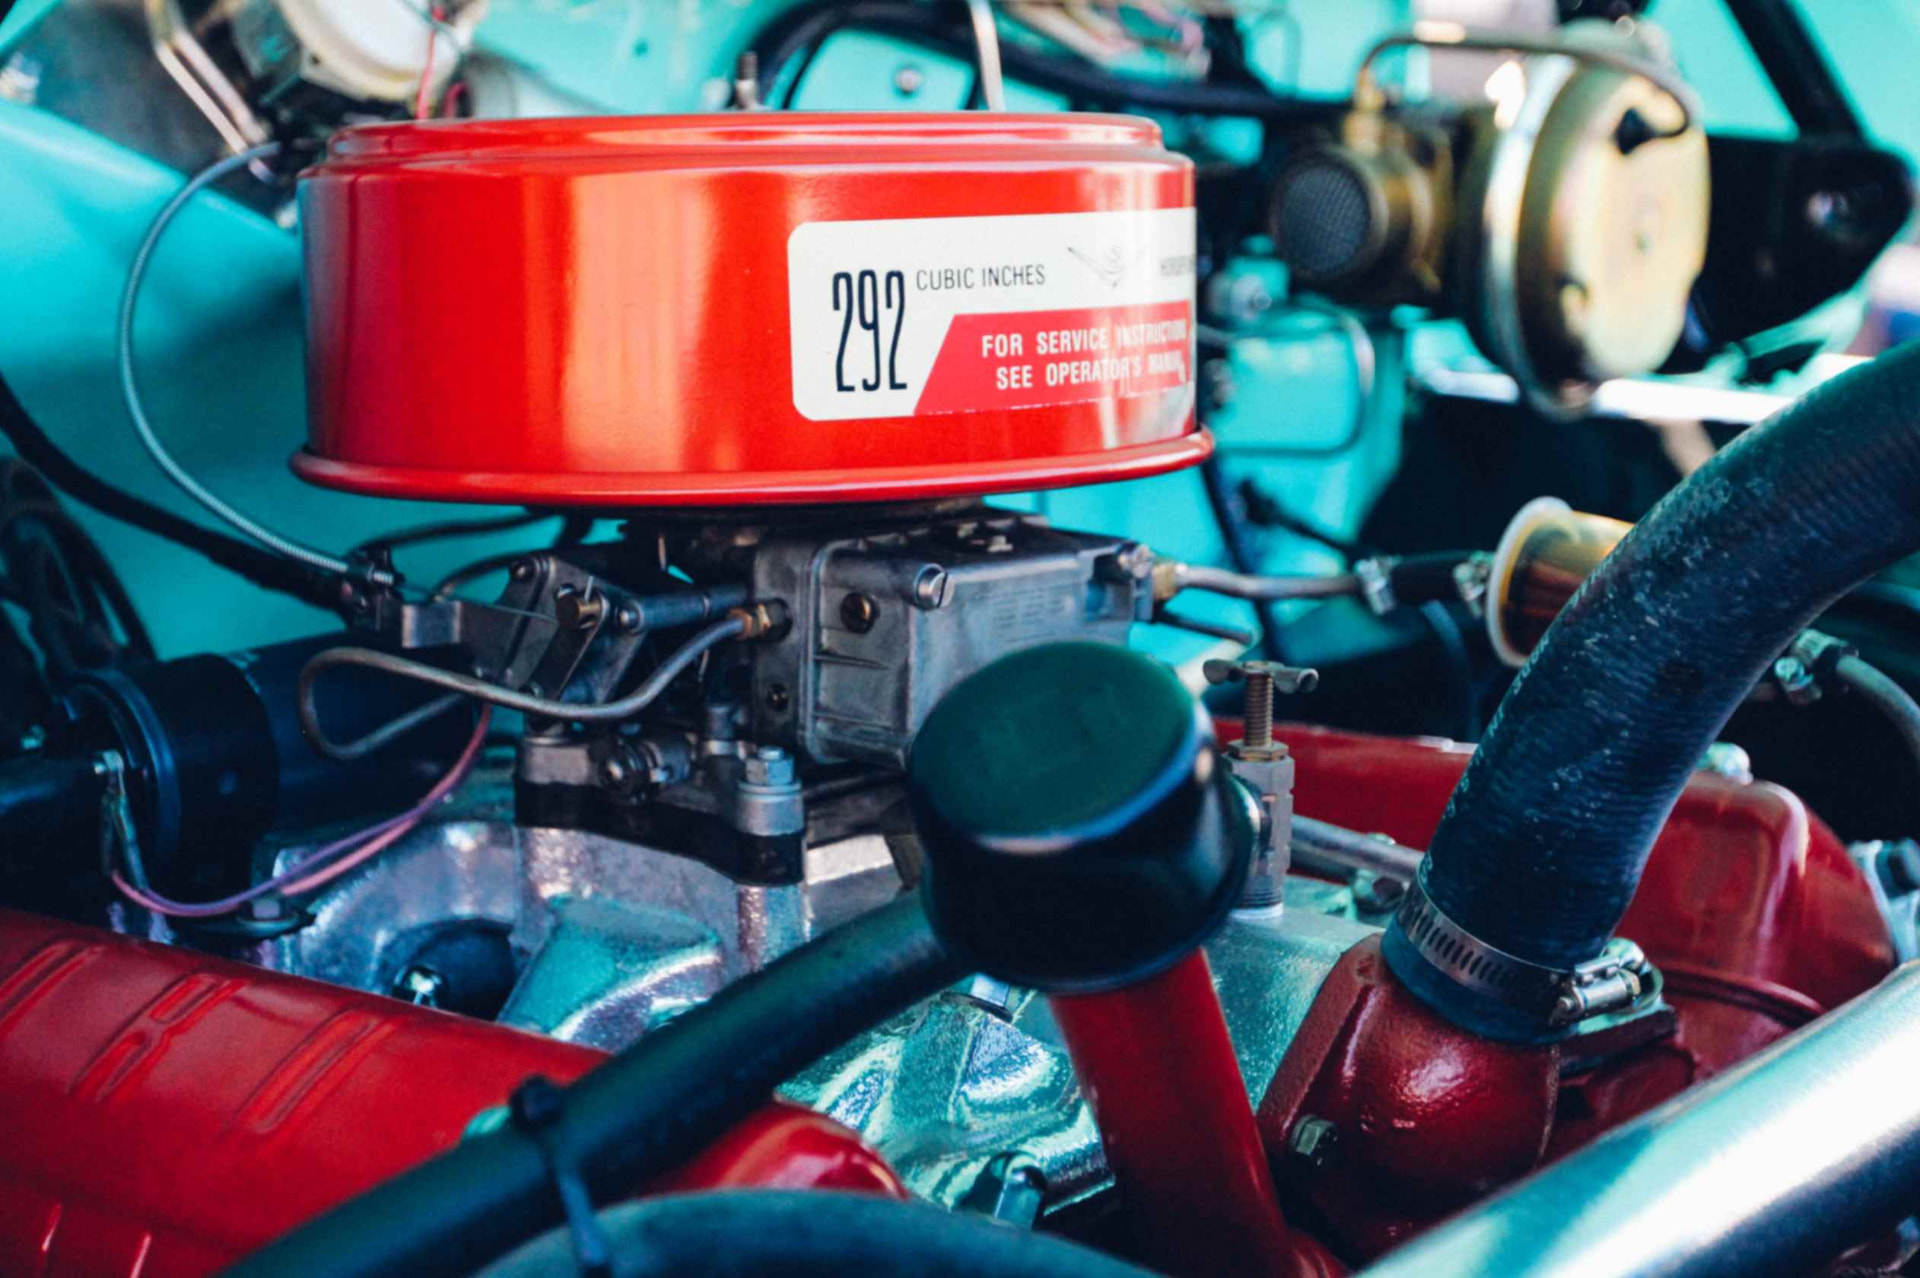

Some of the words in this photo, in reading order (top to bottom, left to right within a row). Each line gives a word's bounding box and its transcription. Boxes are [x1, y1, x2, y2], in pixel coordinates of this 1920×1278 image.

[915, 267, 975, 291] CUBIC
[981, 264, 1046, 288] INCHES
[832, 269, 908, 392] 292
[981, 332, 1023, 358] FOR
[1036, 327, 1108, 355] SERVICE
[996, 365, 1033, 390] SEE
